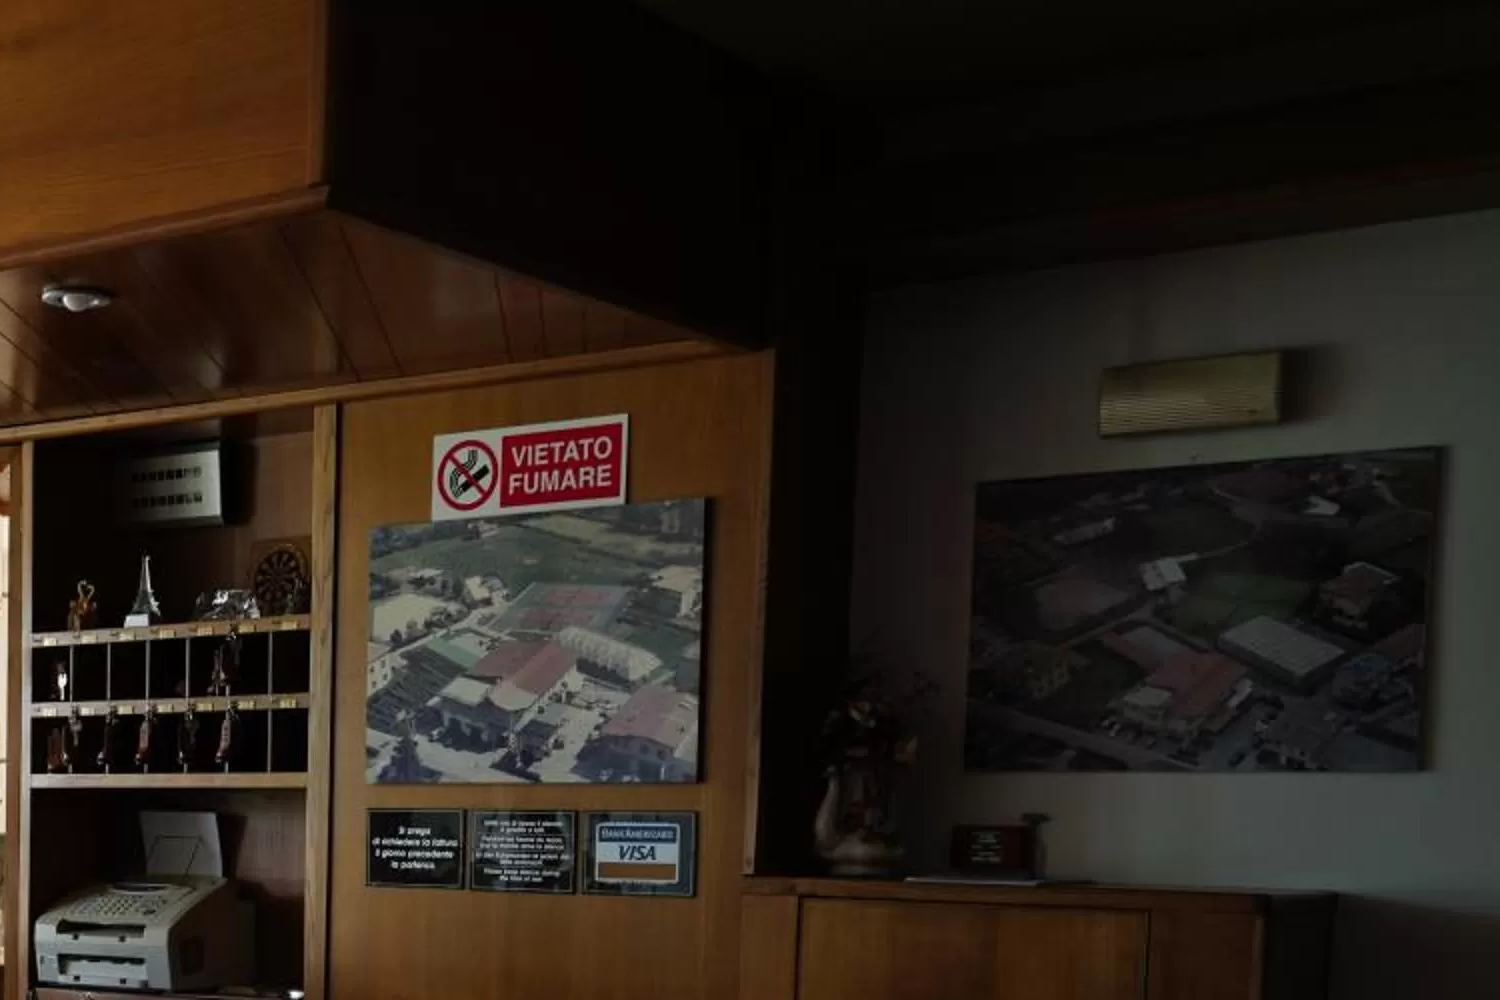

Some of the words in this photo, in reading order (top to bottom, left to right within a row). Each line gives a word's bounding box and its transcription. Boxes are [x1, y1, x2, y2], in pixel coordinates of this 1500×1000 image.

[511, 436, 613, 468] VIETATO
[508, 464, 613, 496] FUMARE
[618, 845, 657, 861] VISA
